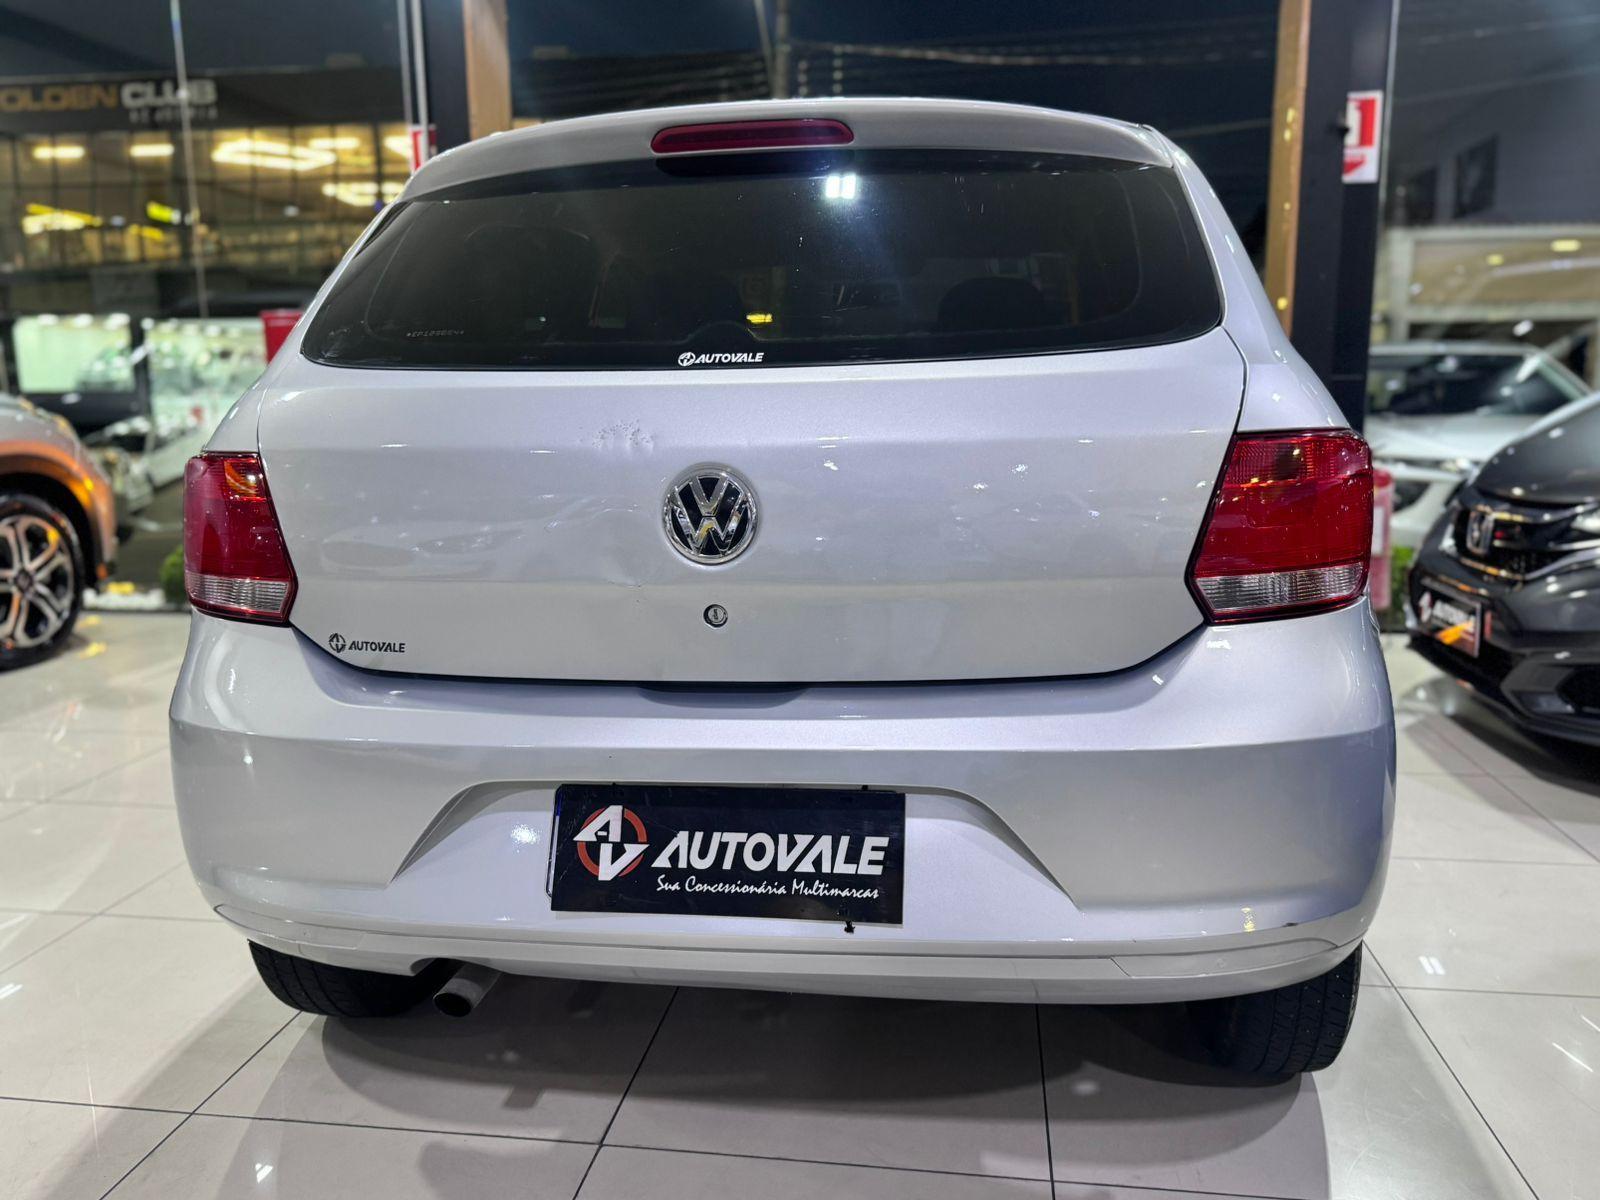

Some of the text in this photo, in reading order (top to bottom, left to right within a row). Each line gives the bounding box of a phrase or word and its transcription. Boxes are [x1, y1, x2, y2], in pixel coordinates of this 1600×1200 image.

[695, 352, 764, 364] AUTOVALE
[348, 640, 406, 653] AUTOVALE
[651, 830, 890, 876] AUTOVALE
[656, 874, 880, 899] Sua Concessionária Multimarcas
